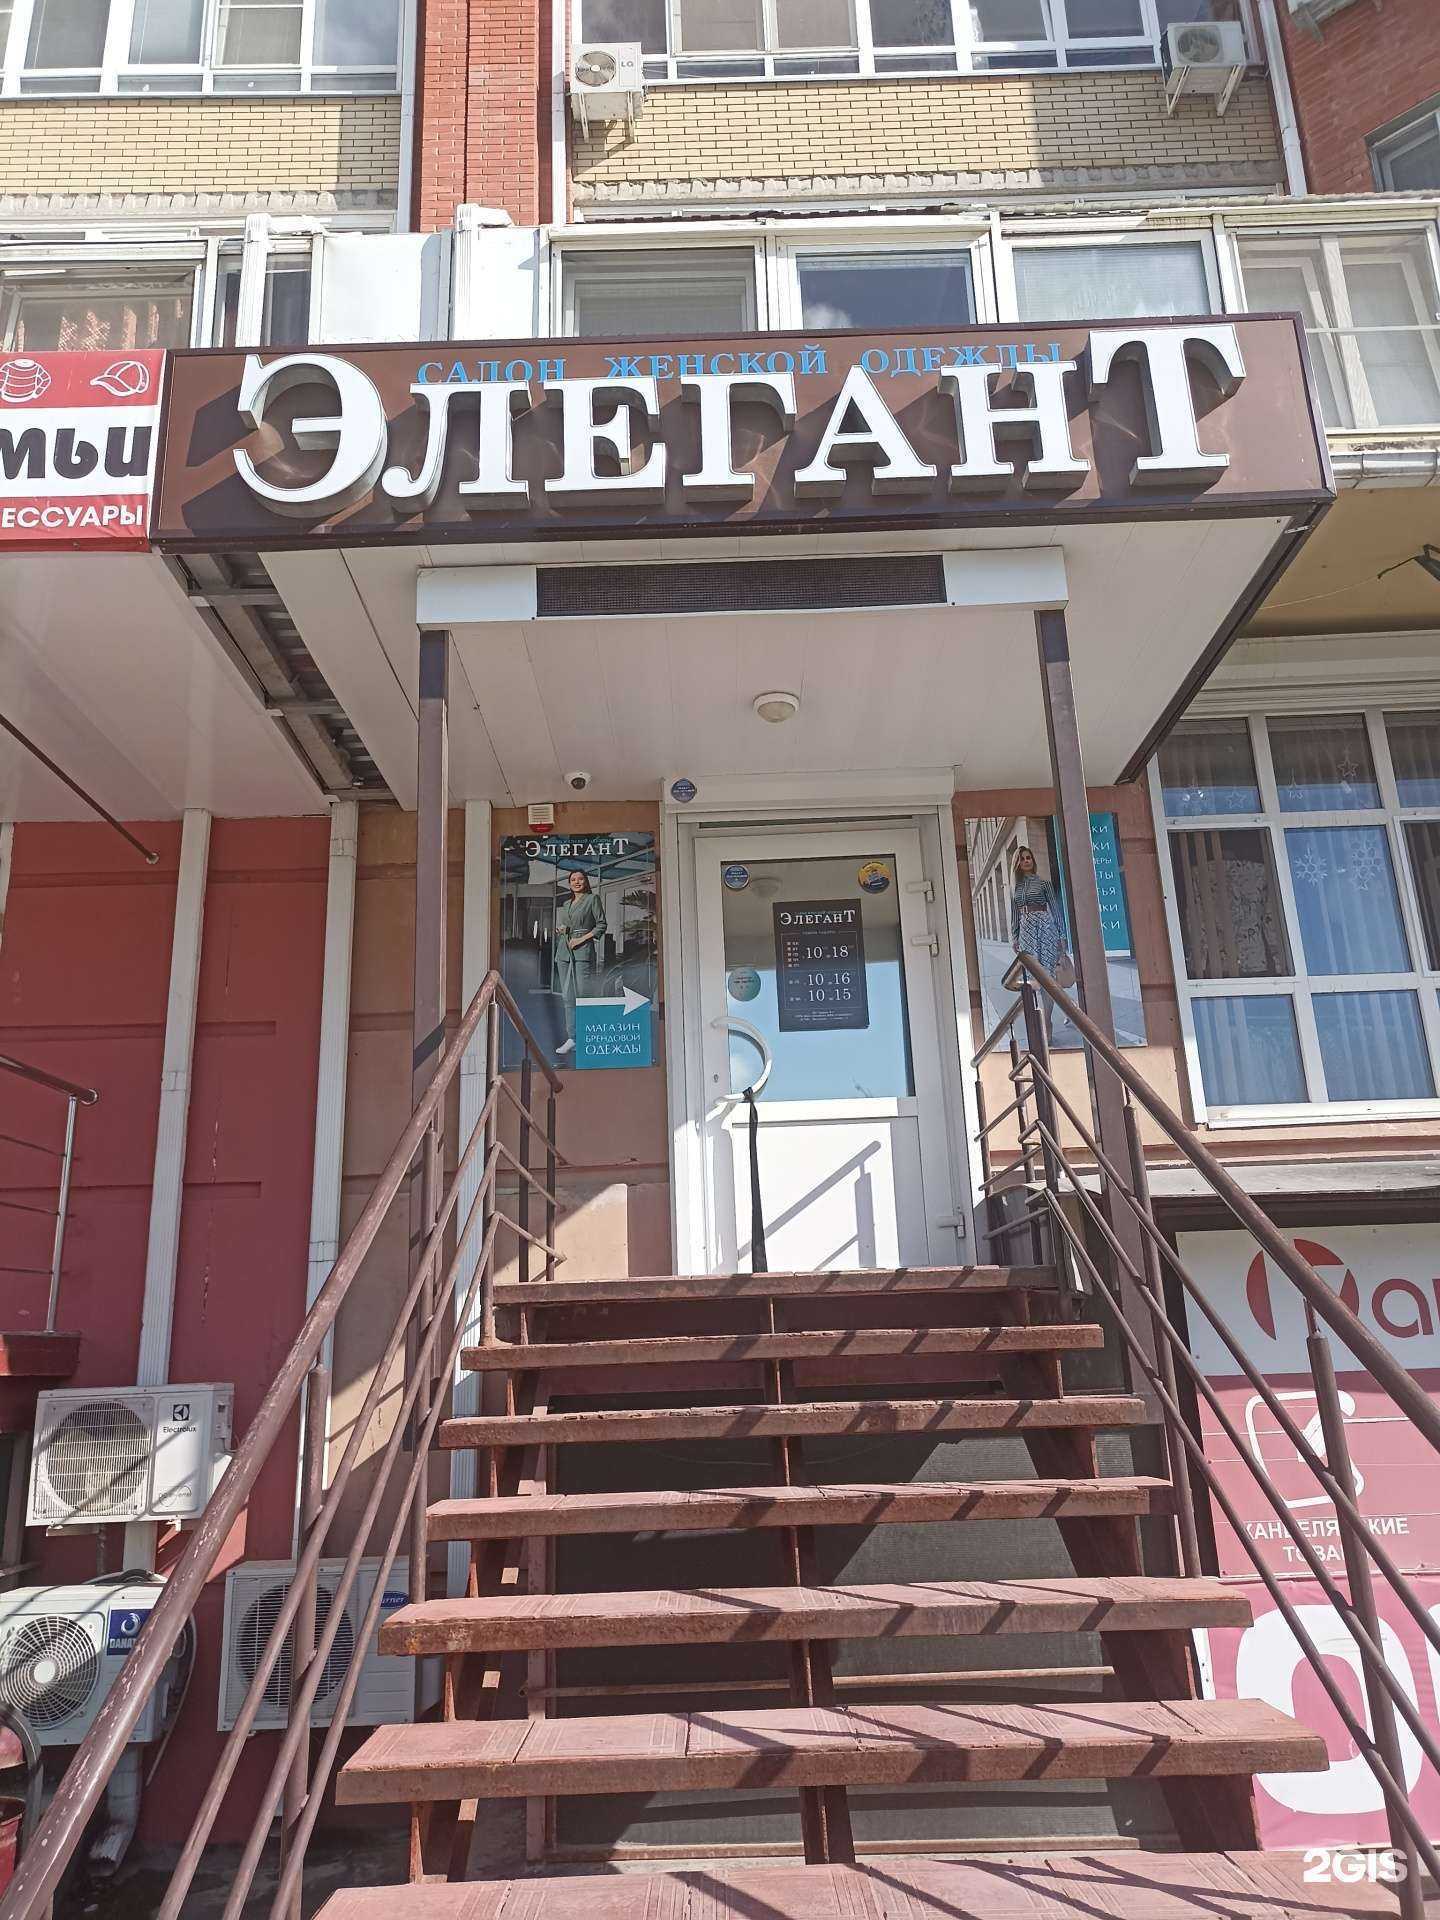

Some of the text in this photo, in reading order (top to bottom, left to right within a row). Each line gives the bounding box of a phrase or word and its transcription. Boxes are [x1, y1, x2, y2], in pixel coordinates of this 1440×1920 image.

[416, 343, 1064, 385] САЛОН ЖЕНСКОЙ ОДЕЖДЫ
[232, 324, 1247, 510] ЭЛЕГАНТ
[525, 838, 629, 858] ЭЛЕГАНТ
[780, 909, 856, 925] ЭЛЕГАНТ
[805, 946, 823, 959] 10
[832, 945, 849, 958] 18
[807, 971, 851, 986] 10 16
[808, 988, 851, 1001] 10 15
[585, 1023, 640, 1032] МАГАЗИН
[585, 1033, 641, 1043] БРЕНДОВОЙ
[585, 1044, 641, 1055] ОДЕЖДЫ
